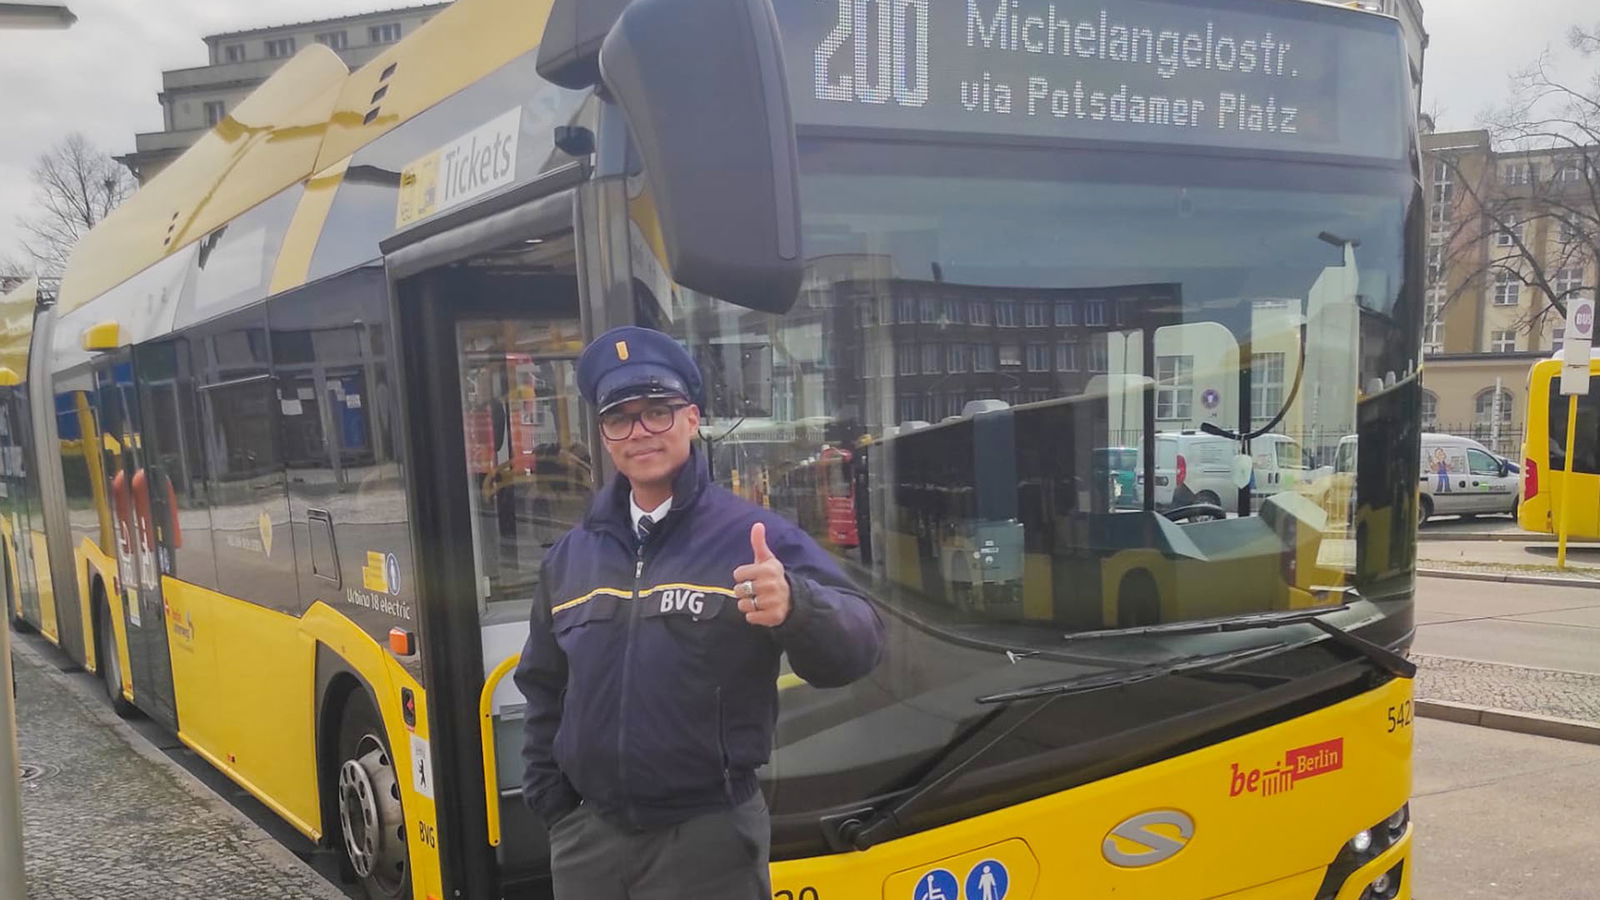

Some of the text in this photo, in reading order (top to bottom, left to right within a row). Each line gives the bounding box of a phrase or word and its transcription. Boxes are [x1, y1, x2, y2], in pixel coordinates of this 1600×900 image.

[815, 0, 928, 107] 200
[967, 0, 1297, 78] Michelangelostr.
[960, 71, 1297, 133] via Potsdamer Platz
[445, 131, 512, 200] Tickets
[1576, 312, 1591, 325] BUS
[346, 587, 411, 620] Urbino 18 electric
[660, 590, 705, 614] BVG
[1230, 749, 1338, 797] be Berlin
[419, 820, 435, 849] BVG
